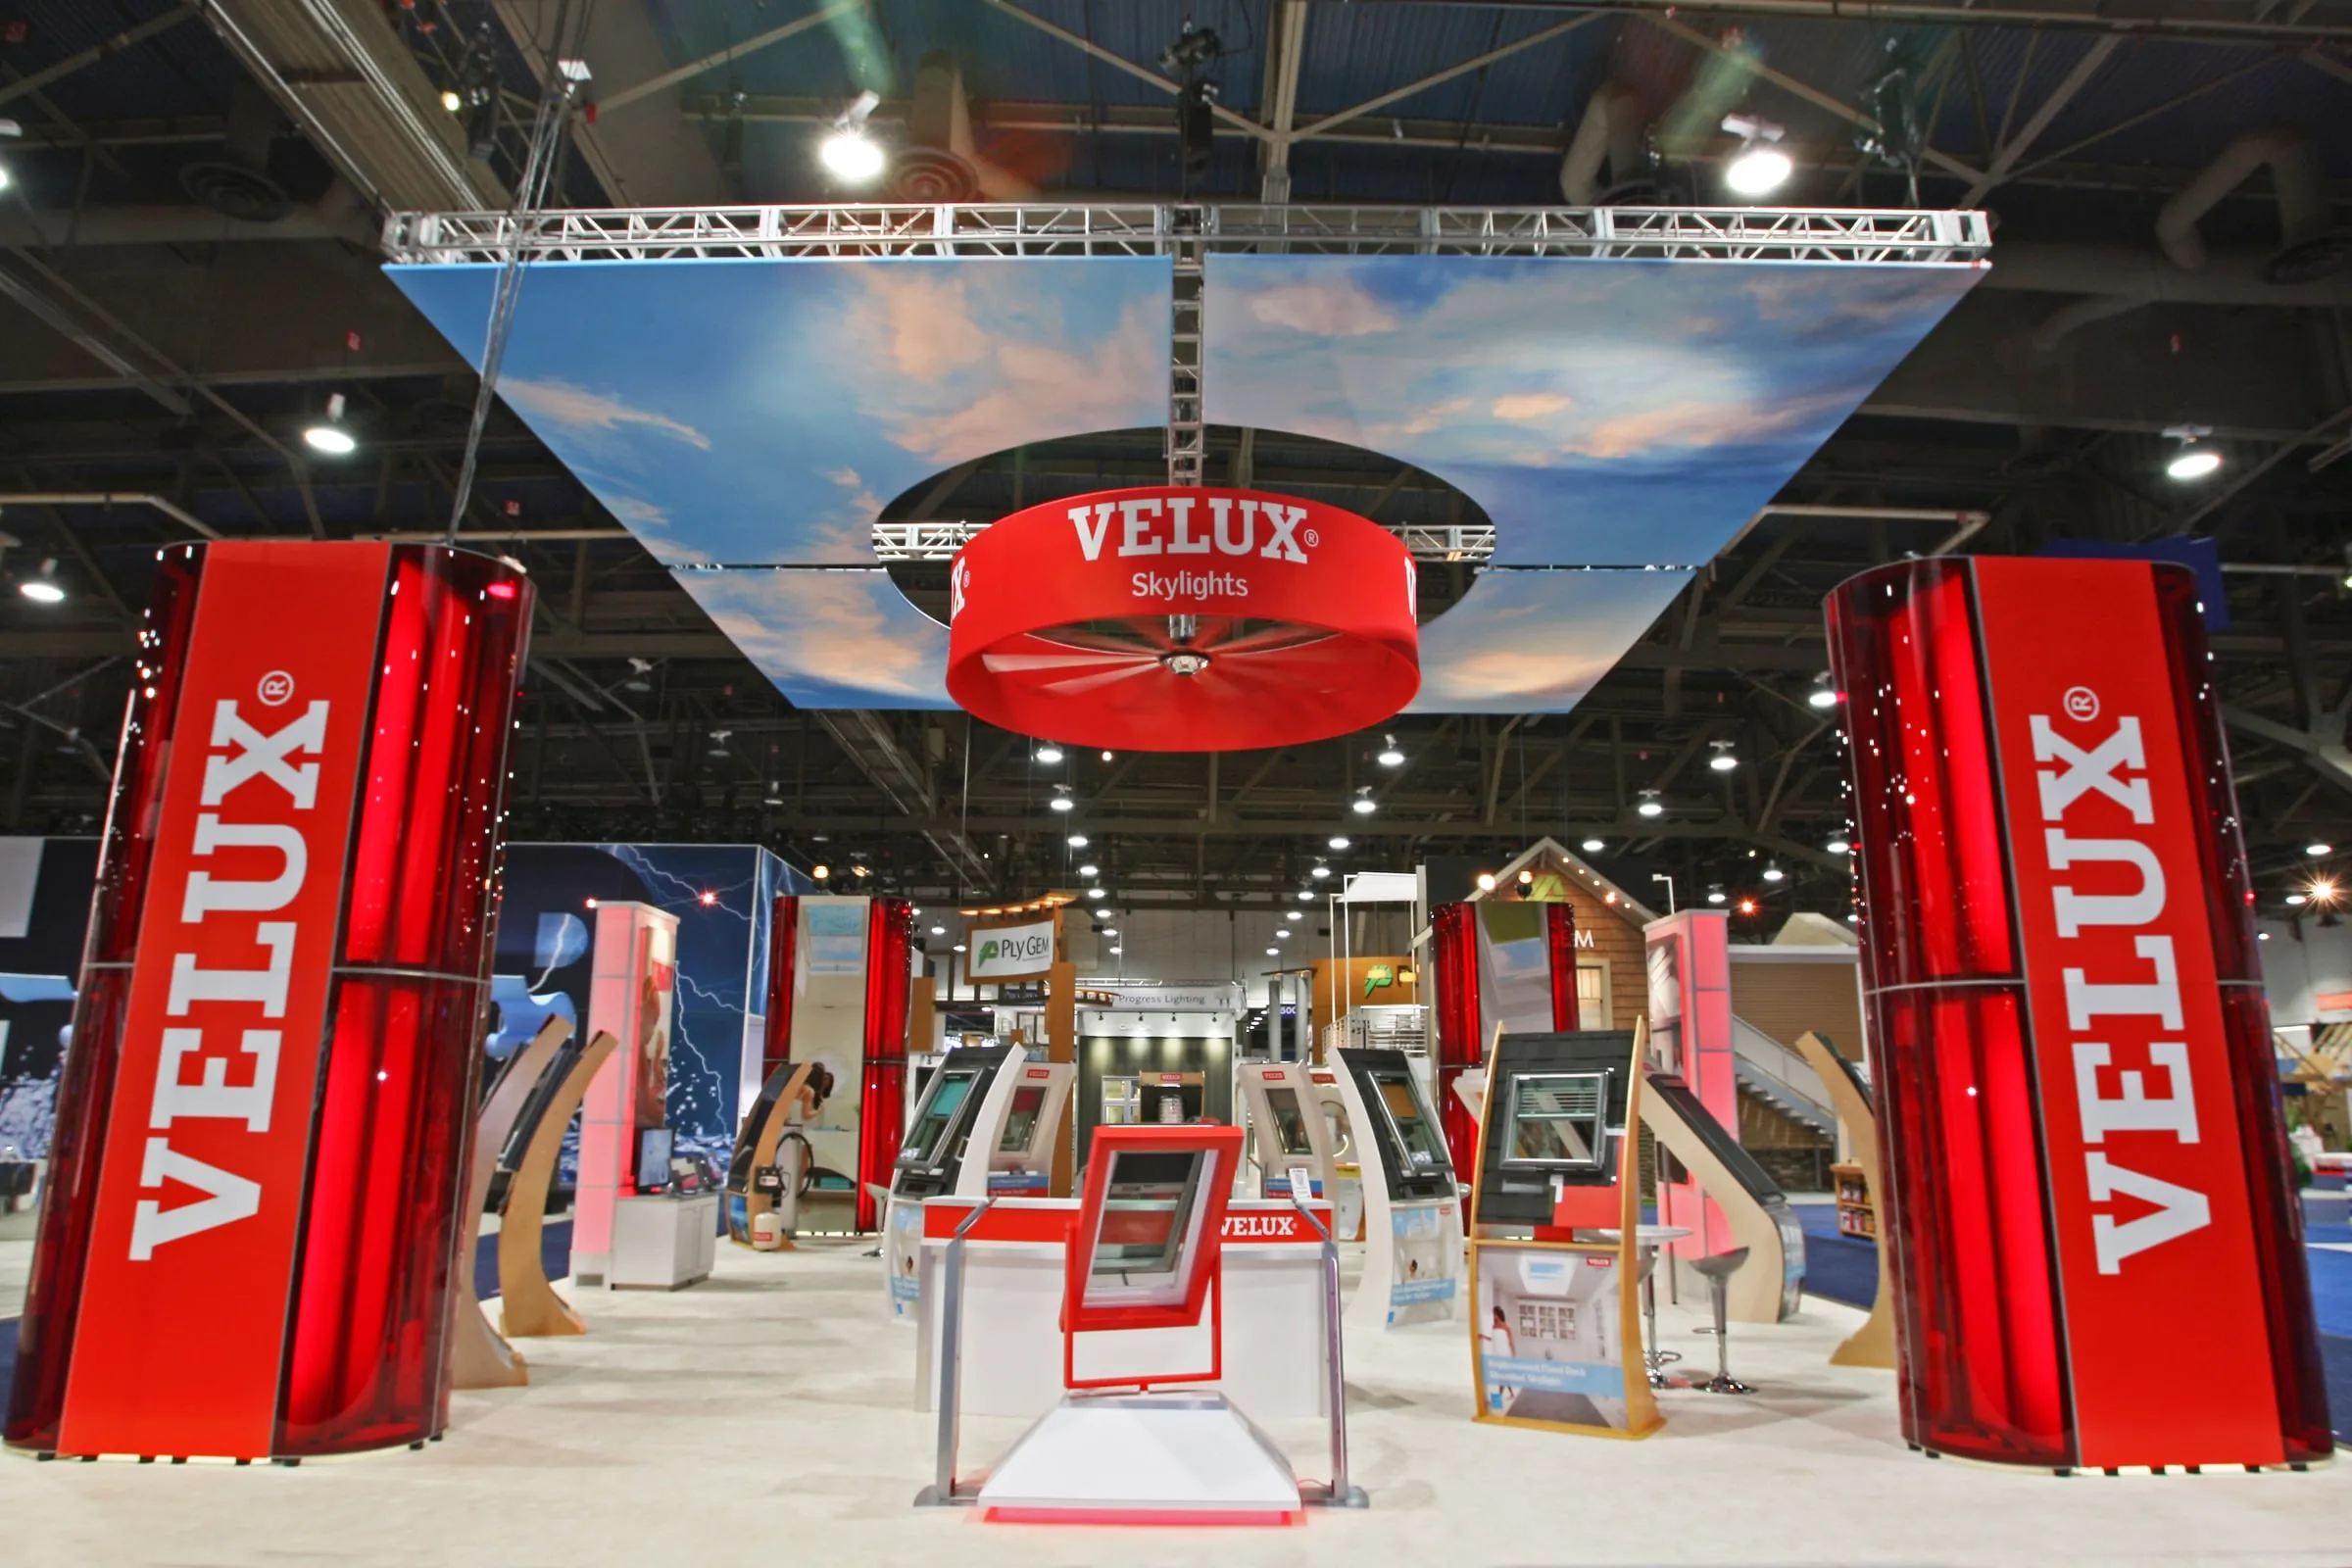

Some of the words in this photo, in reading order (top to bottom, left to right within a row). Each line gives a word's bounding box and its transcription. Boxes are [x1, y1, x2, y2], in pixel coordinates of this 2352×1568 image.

[1132, 570, 1249, 601] Skylights
[1118, 994, 1161, 1005] Progress
[1164, 995, 1205, 1005] Lighting
